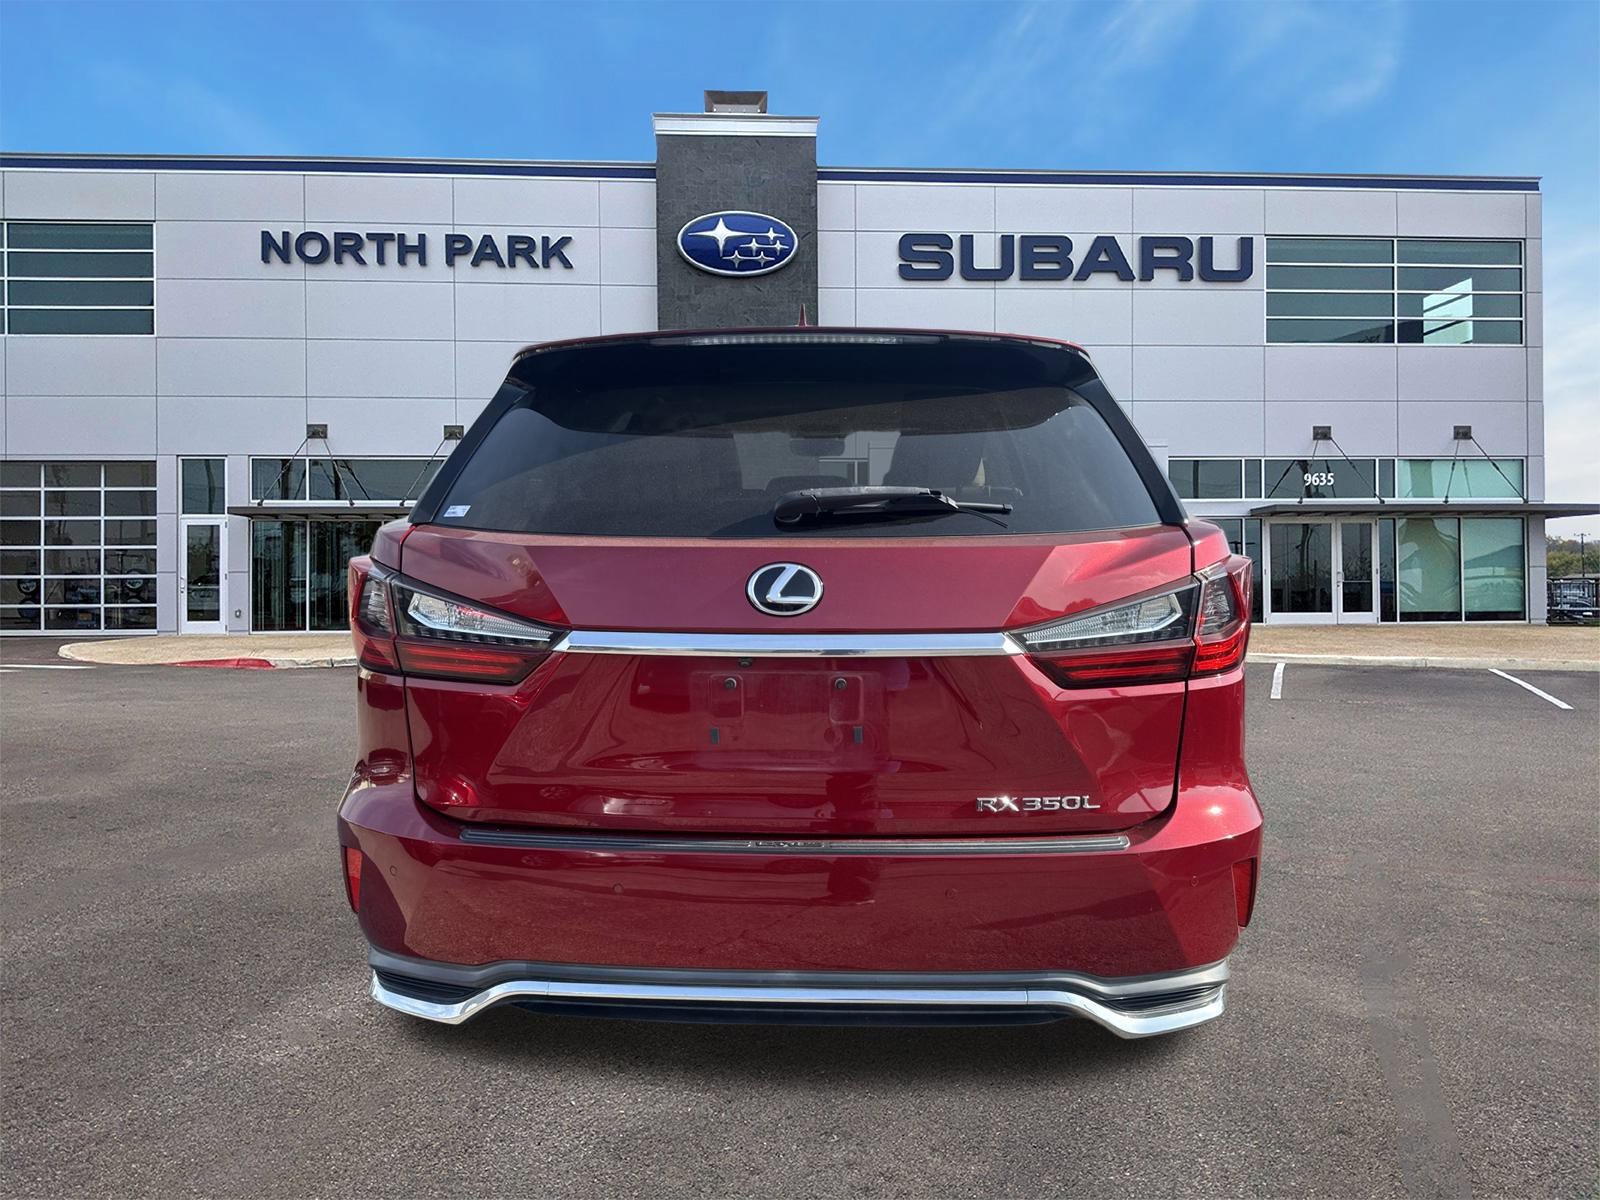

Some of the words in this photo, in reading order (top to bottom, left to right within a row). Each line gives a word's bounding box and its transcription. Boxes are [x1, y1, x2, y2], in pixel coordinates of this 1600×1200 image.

[260, 230, 427, 266] NORTH
[444, 233, 574, 269] PARK
[898, 233, 1254, 282] SUBARU
[1303, 472, 1335, 486] 9635
